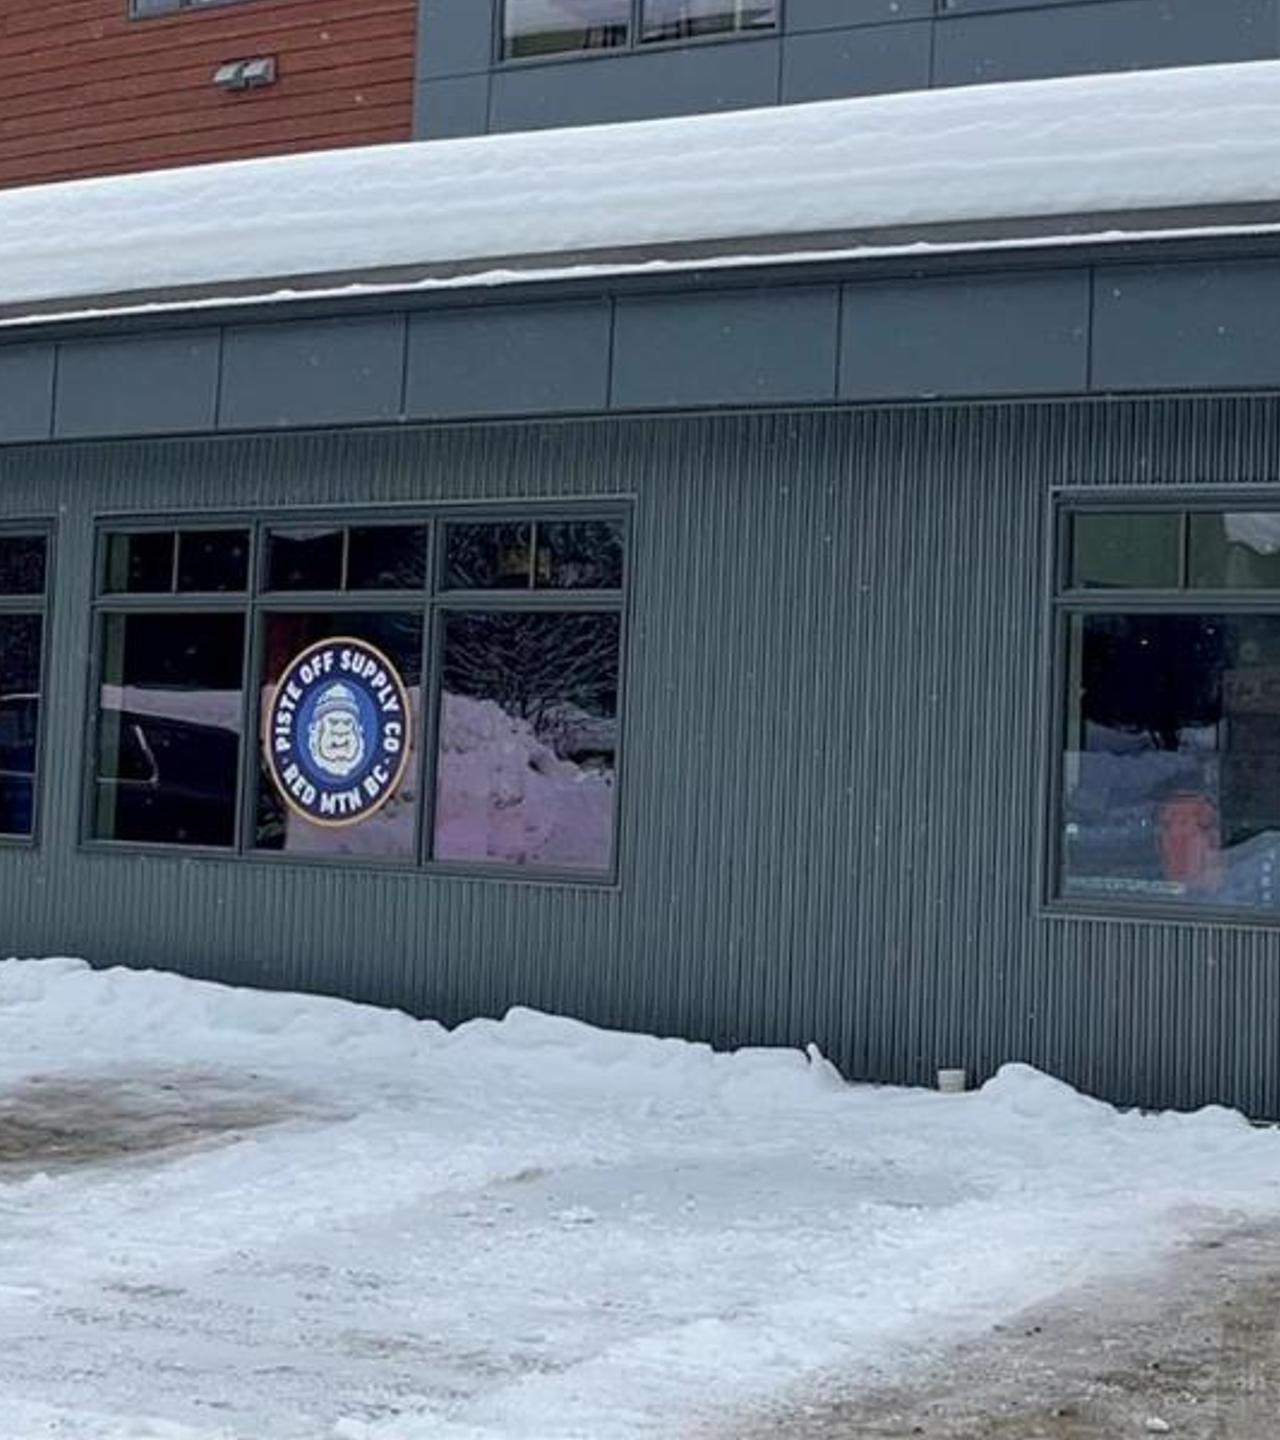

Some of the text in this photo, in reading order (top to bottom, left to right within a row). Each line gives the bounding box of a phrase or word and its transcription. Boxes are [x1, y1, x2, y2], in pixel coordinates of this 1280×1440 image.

[275, 649, 402, 753] PISTE OFF SUPPLY CO
[282, 763, 389, 814] RED MTN BC
